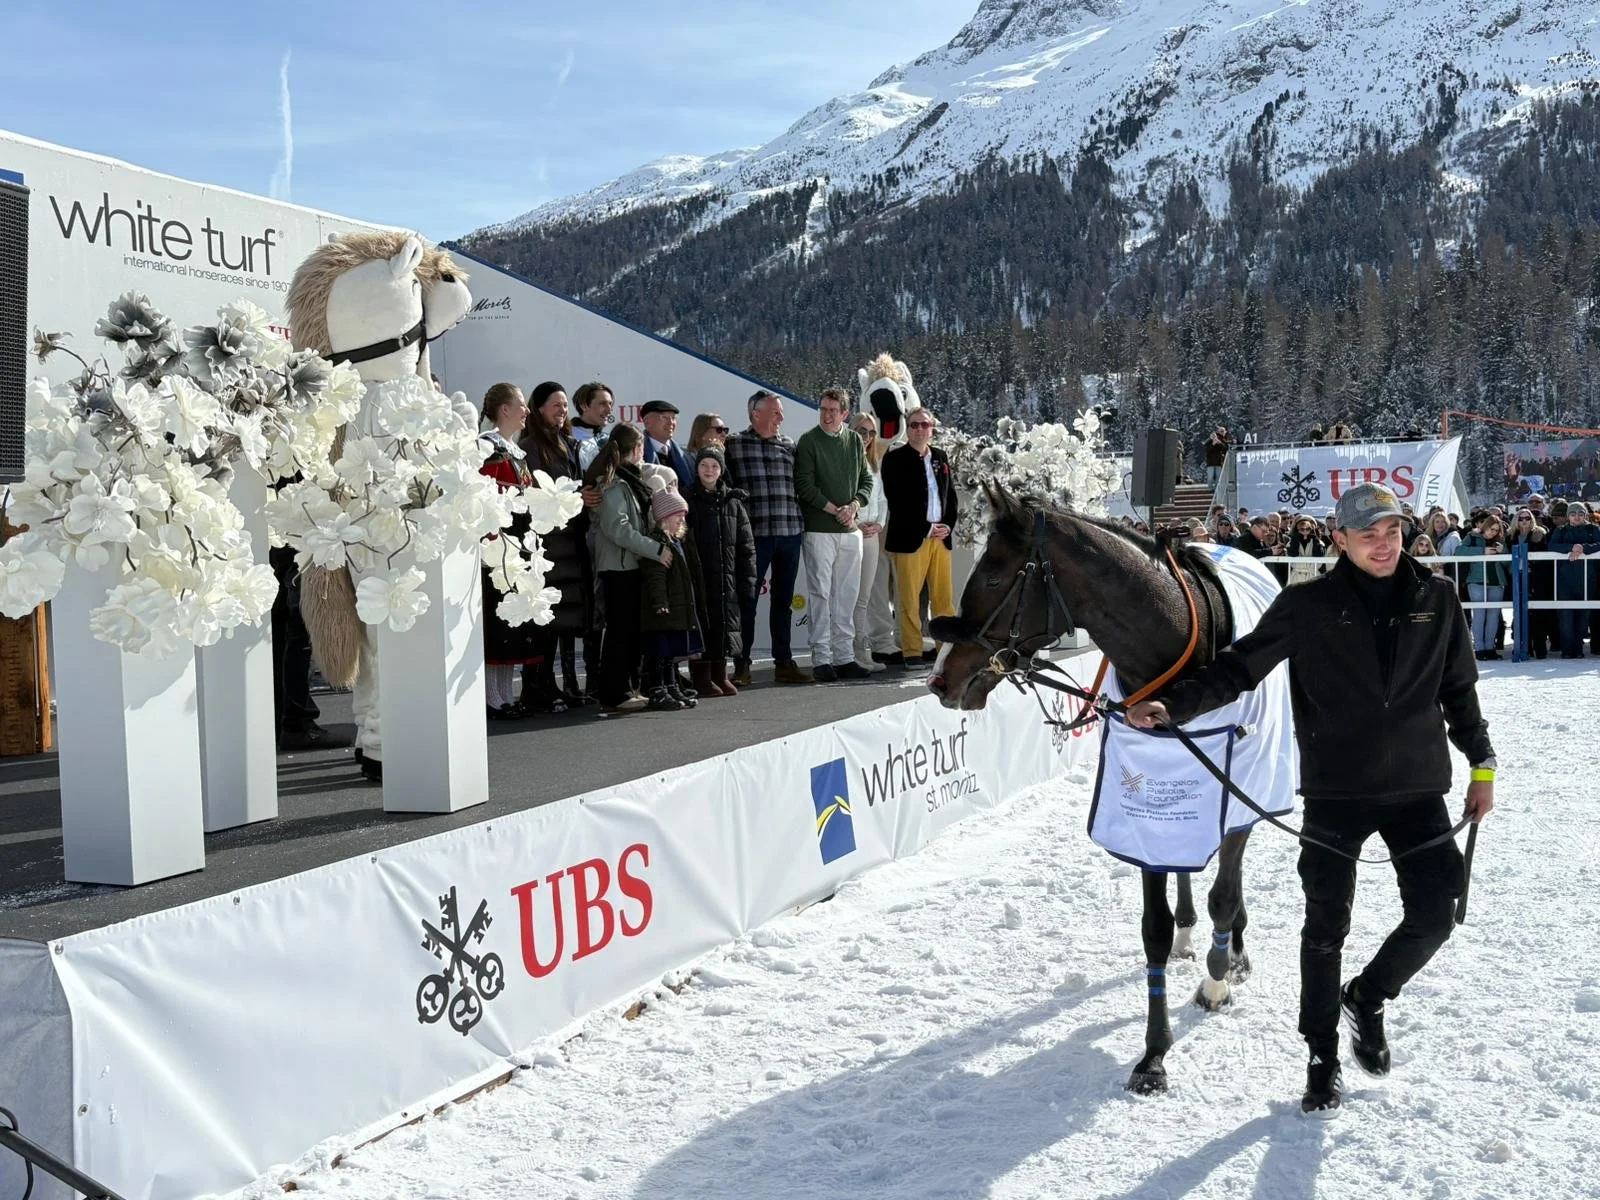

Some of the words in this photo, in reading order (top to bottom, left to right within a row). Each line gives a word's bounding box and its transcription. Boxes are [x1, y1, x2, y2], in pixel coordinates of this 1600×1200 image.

[49, 192, 193, 261] white
[201, 217, 276, 275] turf
[123, 254, 187, 275] international
[188, 265, 244, 285] horseraces
[245, 276, 270, 289] since
[1243, 432, 1258, 444] A1
[931, 717, 968, 777] turf
[510, 842, 653, 979] UBS
